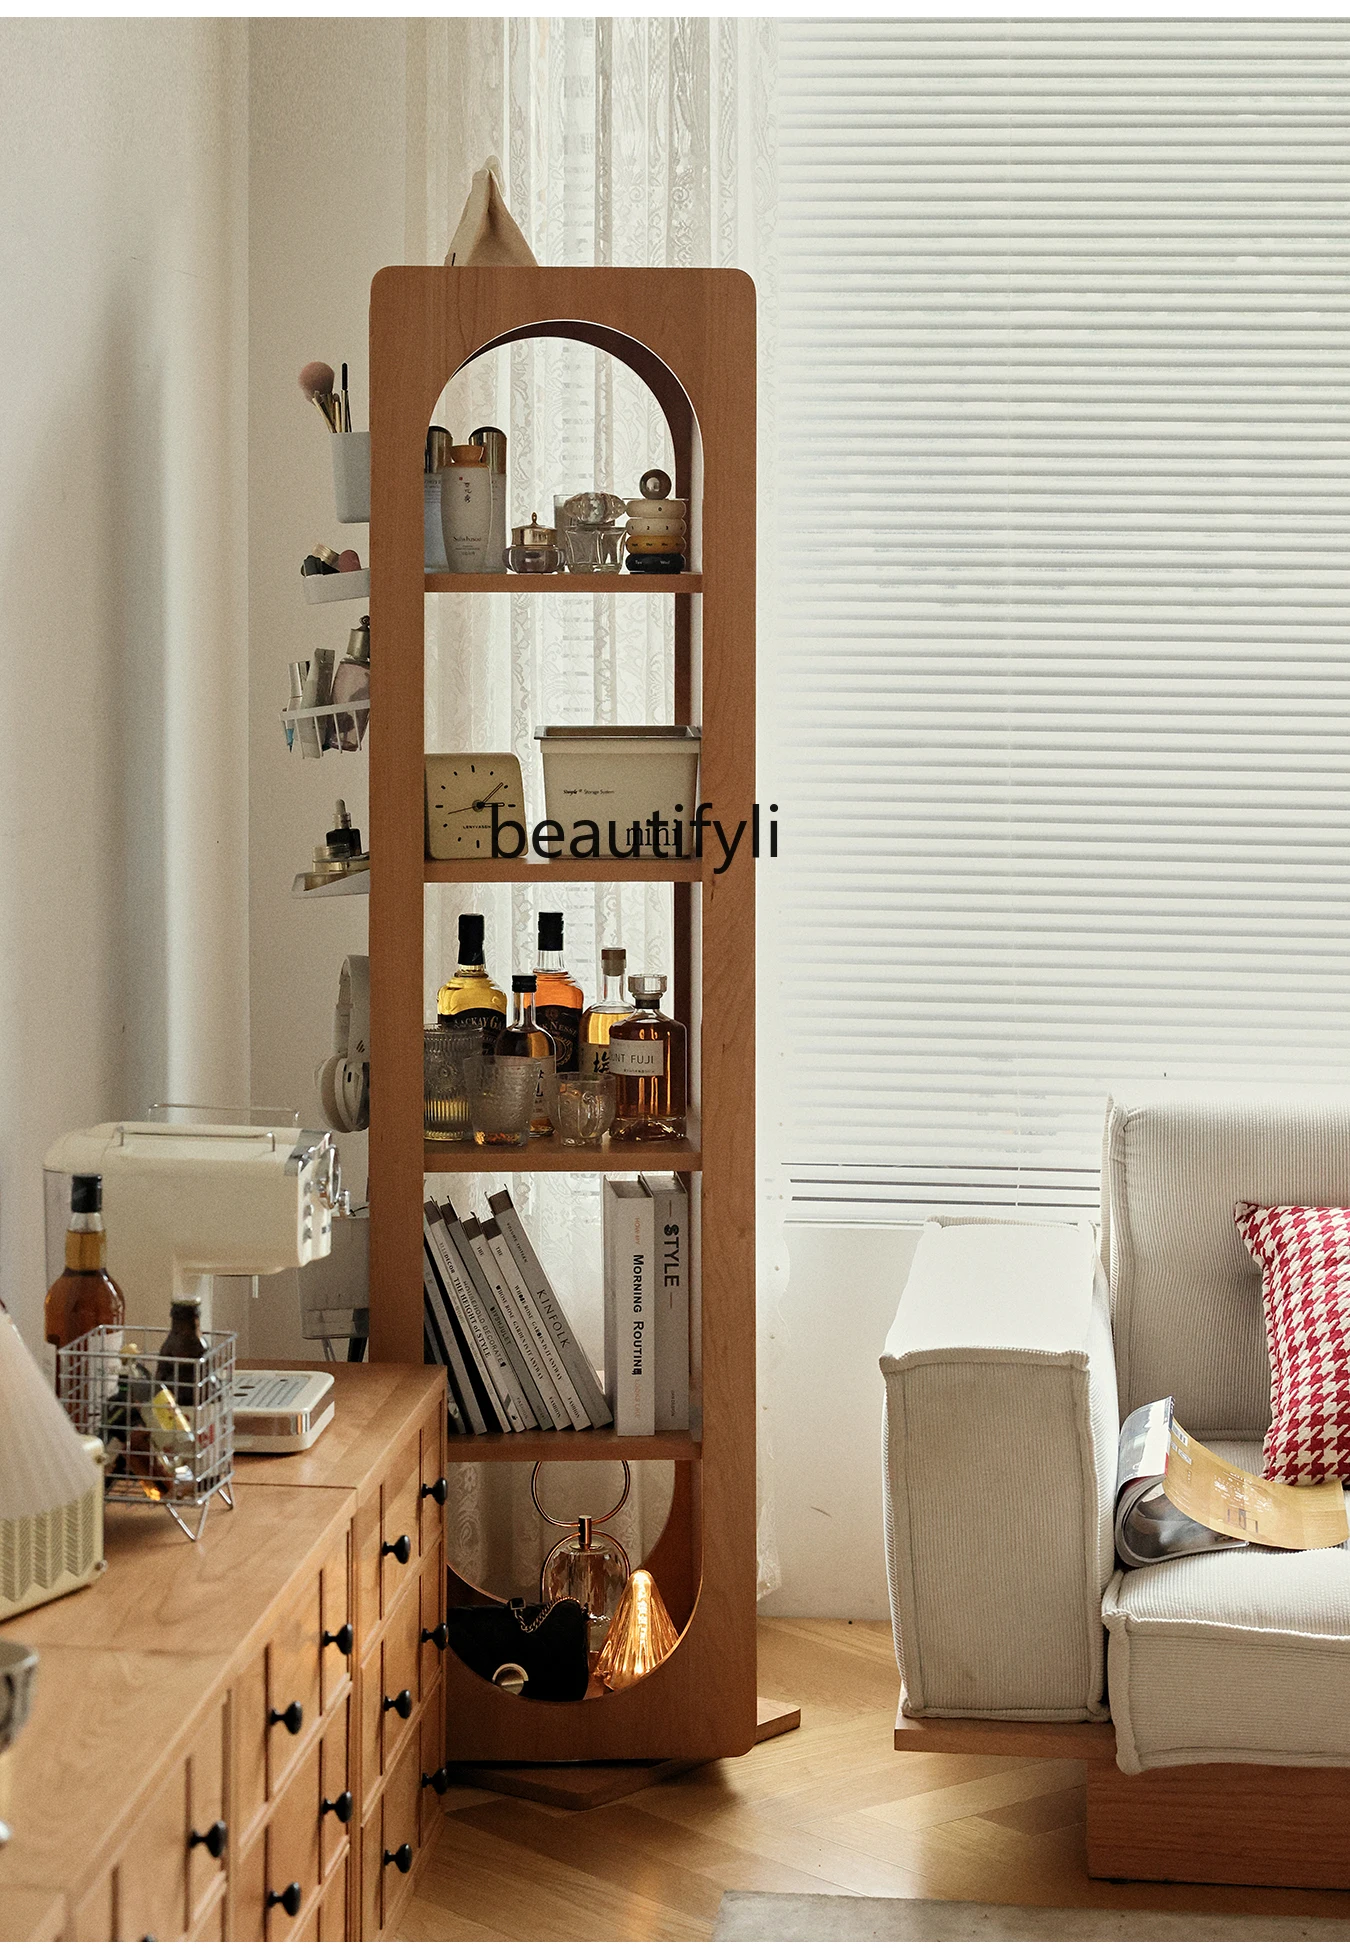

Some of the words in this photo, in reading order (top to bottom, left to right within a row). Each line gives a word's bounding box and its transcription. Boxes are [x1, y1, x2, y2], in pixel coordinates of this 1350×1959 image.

[629, 1054, 655, 1065] FUJI
[633, 1254, 644, 1313] MORNING
[664, 1224, 680, 1288] STYLE
[453, 1276, 464, 1294] THE
[459, 1292, 477, 1324] HEIGHT
[476, 1331, 492, 1359] STYLE
[495, 1284, 508, 1304] HOSE
[537, 1289, 571, 1349] KINFOLK
[531, 1321, 546, 1344] GAREN
